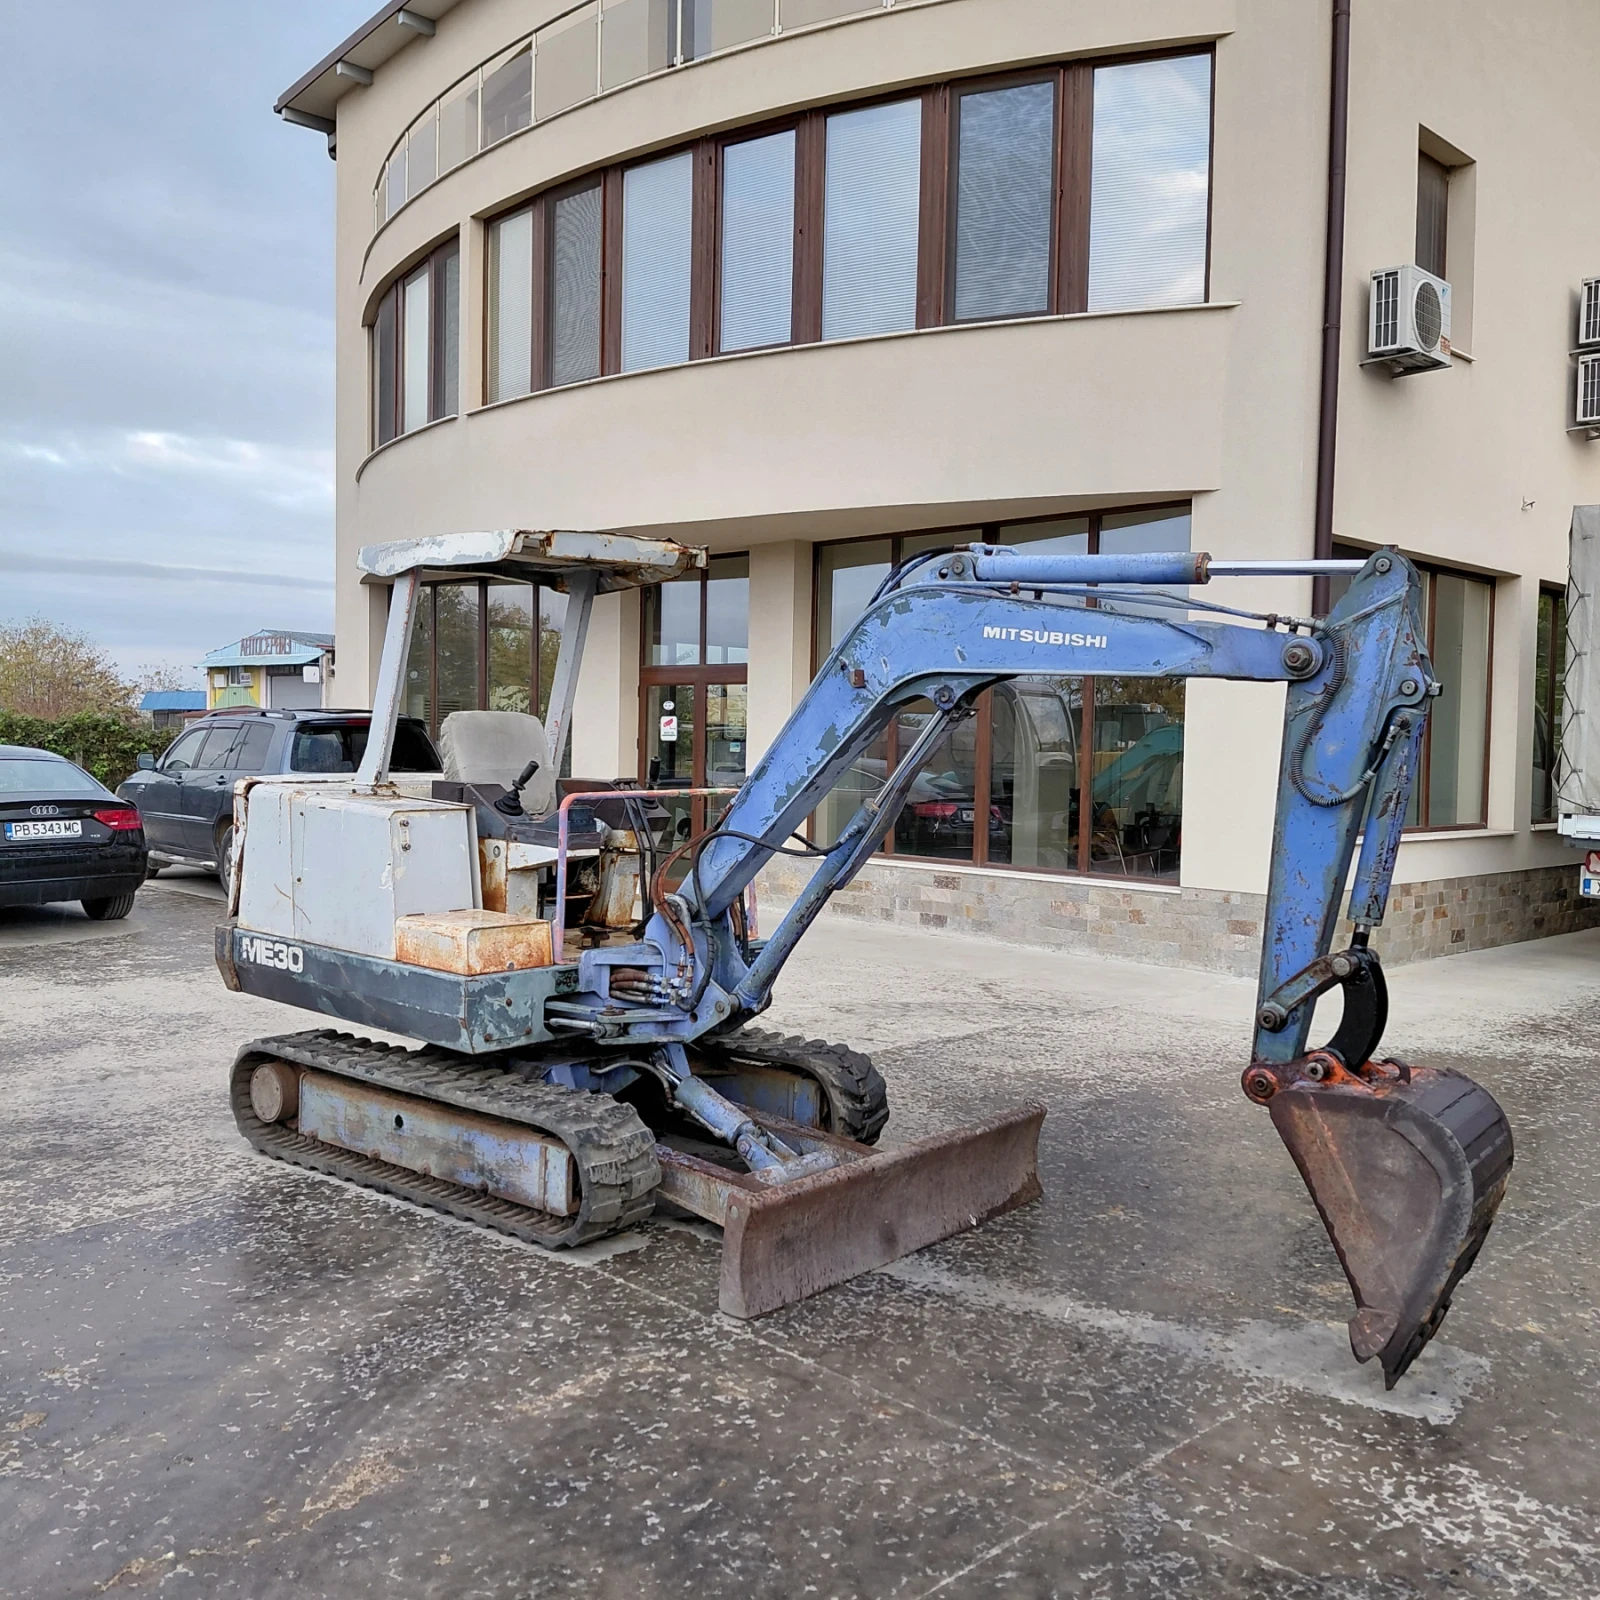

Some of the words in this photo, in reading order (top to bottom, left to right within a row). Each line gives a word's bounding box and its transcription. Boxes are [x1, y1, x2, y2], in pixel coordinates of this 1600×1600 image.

[983, 626, 1108, 648] MITSUBISHI
[14, 824, 31, 836] PB
[33, 822, 62, 835] 5343
[64, 822, 80, 834] MC
[242, 936, 304, 973] ME30
